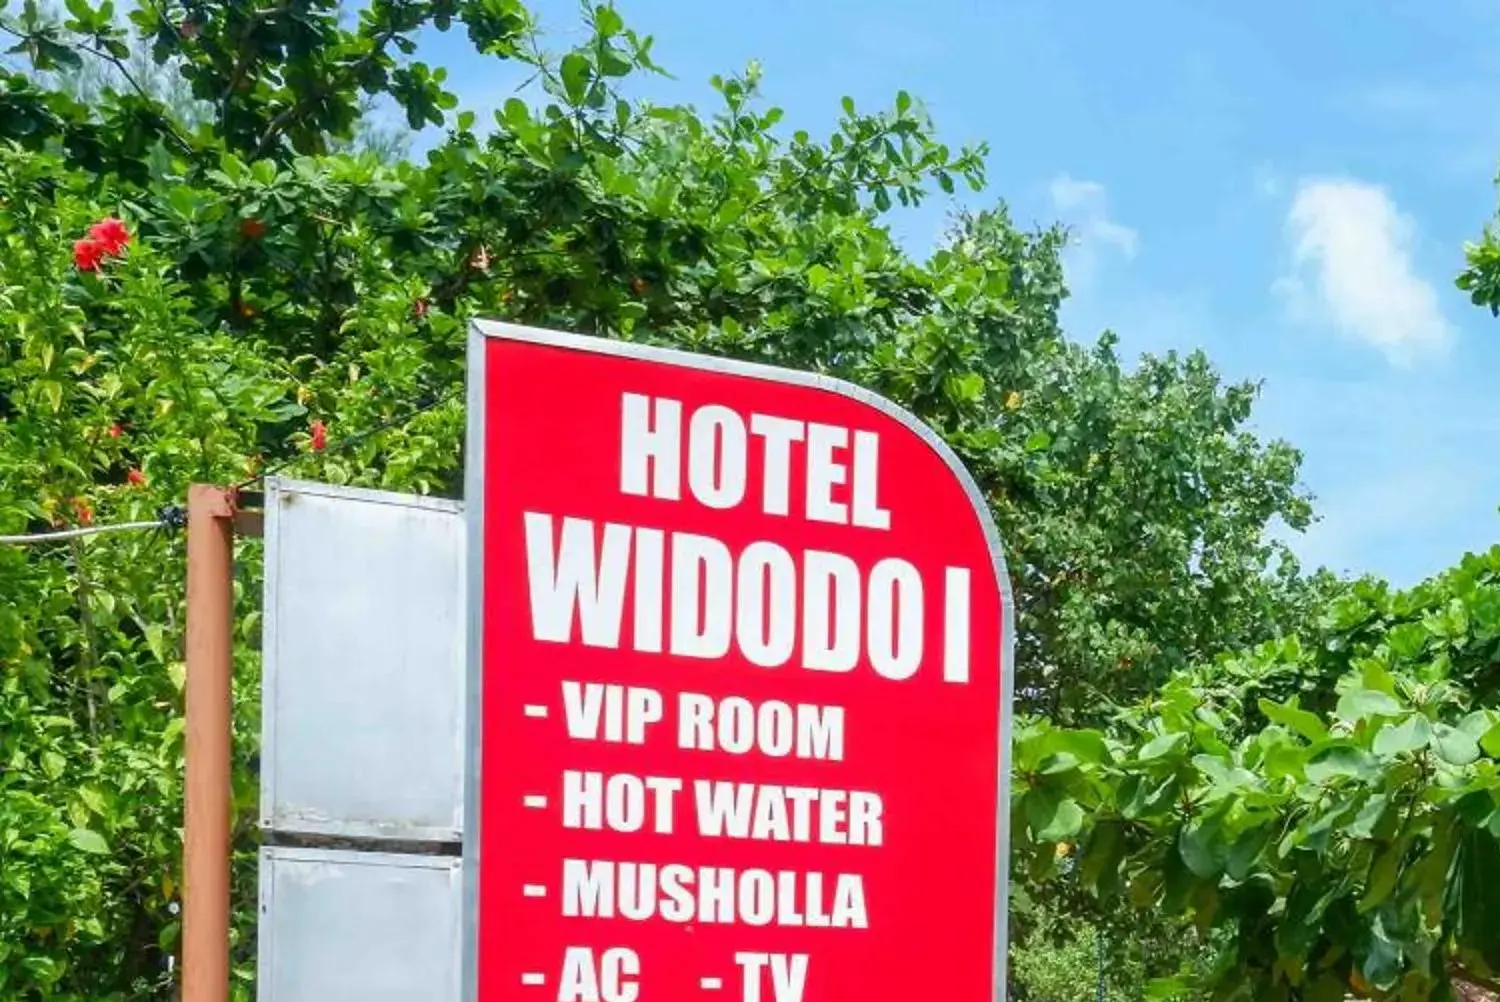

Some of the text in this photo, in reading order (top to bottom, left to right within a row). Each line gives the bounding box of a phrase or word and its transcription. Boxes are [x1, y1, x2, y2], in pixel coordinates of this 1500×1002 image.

[621, 392, 890, 529] HOTEL
[524, 512, 970, 682] WIDODO I
[562, 681, 844, 760] VIP ROOM
[563, 771, 882, 845] HOT WATER
[563, 859, 867, 928] MUSHOLLA
